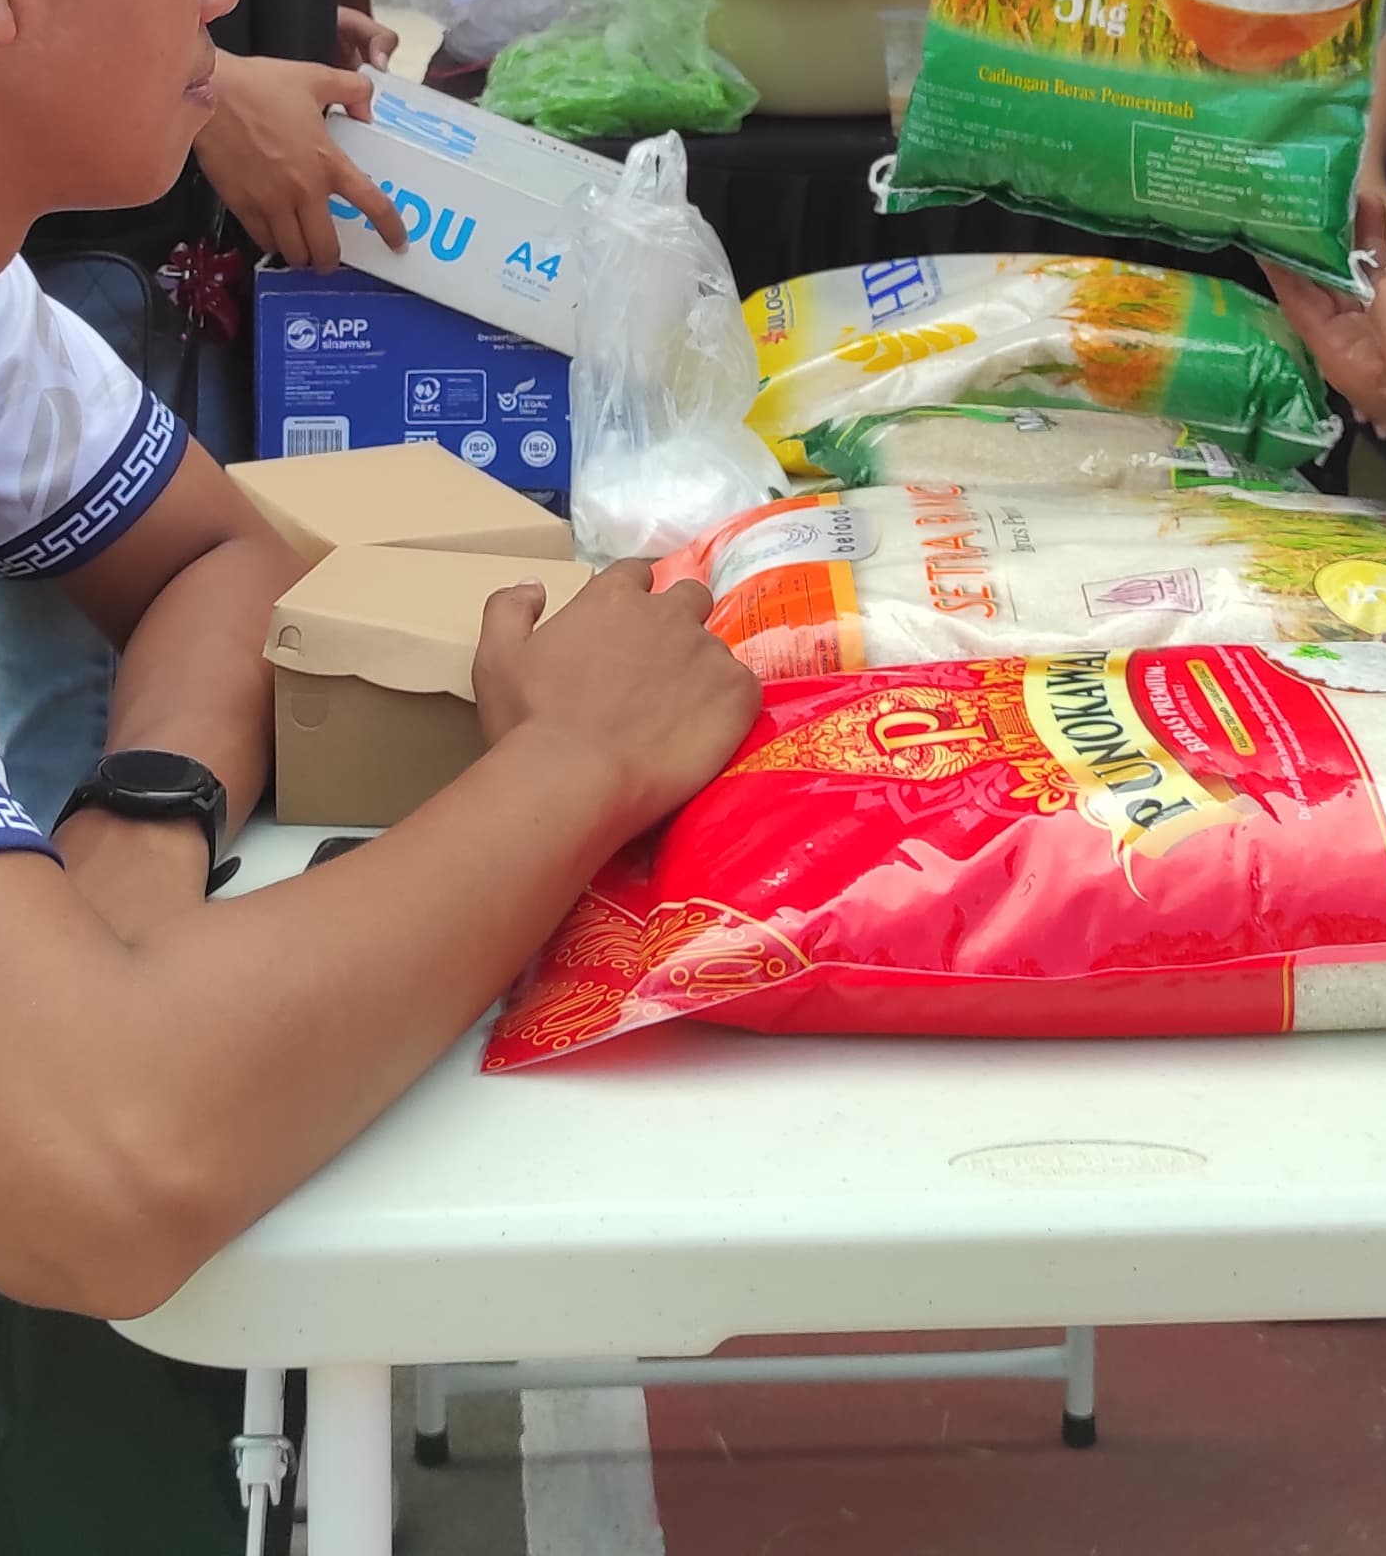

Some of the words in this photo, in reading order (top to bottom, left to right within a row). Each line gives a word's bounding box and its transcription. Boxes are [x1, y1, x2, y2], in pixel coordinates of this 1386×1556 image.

[978, 64, 1050, 94] Cadangan
[1053, 77, 1097, 102] Beras
[1100, 86, 1195, 119] Pemerintah
[505, 241, 562, 282] A4
[322, 318, 368, 338] APP
[469, 442, 490, 452] ISO
[528, 442, 550, 452] ISO
[825, 509, 856, 554] befood
[1144, 666, 1176, 718] PREMIUM
[1046, 650, 1193, 830] PUNOKAWA
[1162, 718, 1211, 754] BERAS
